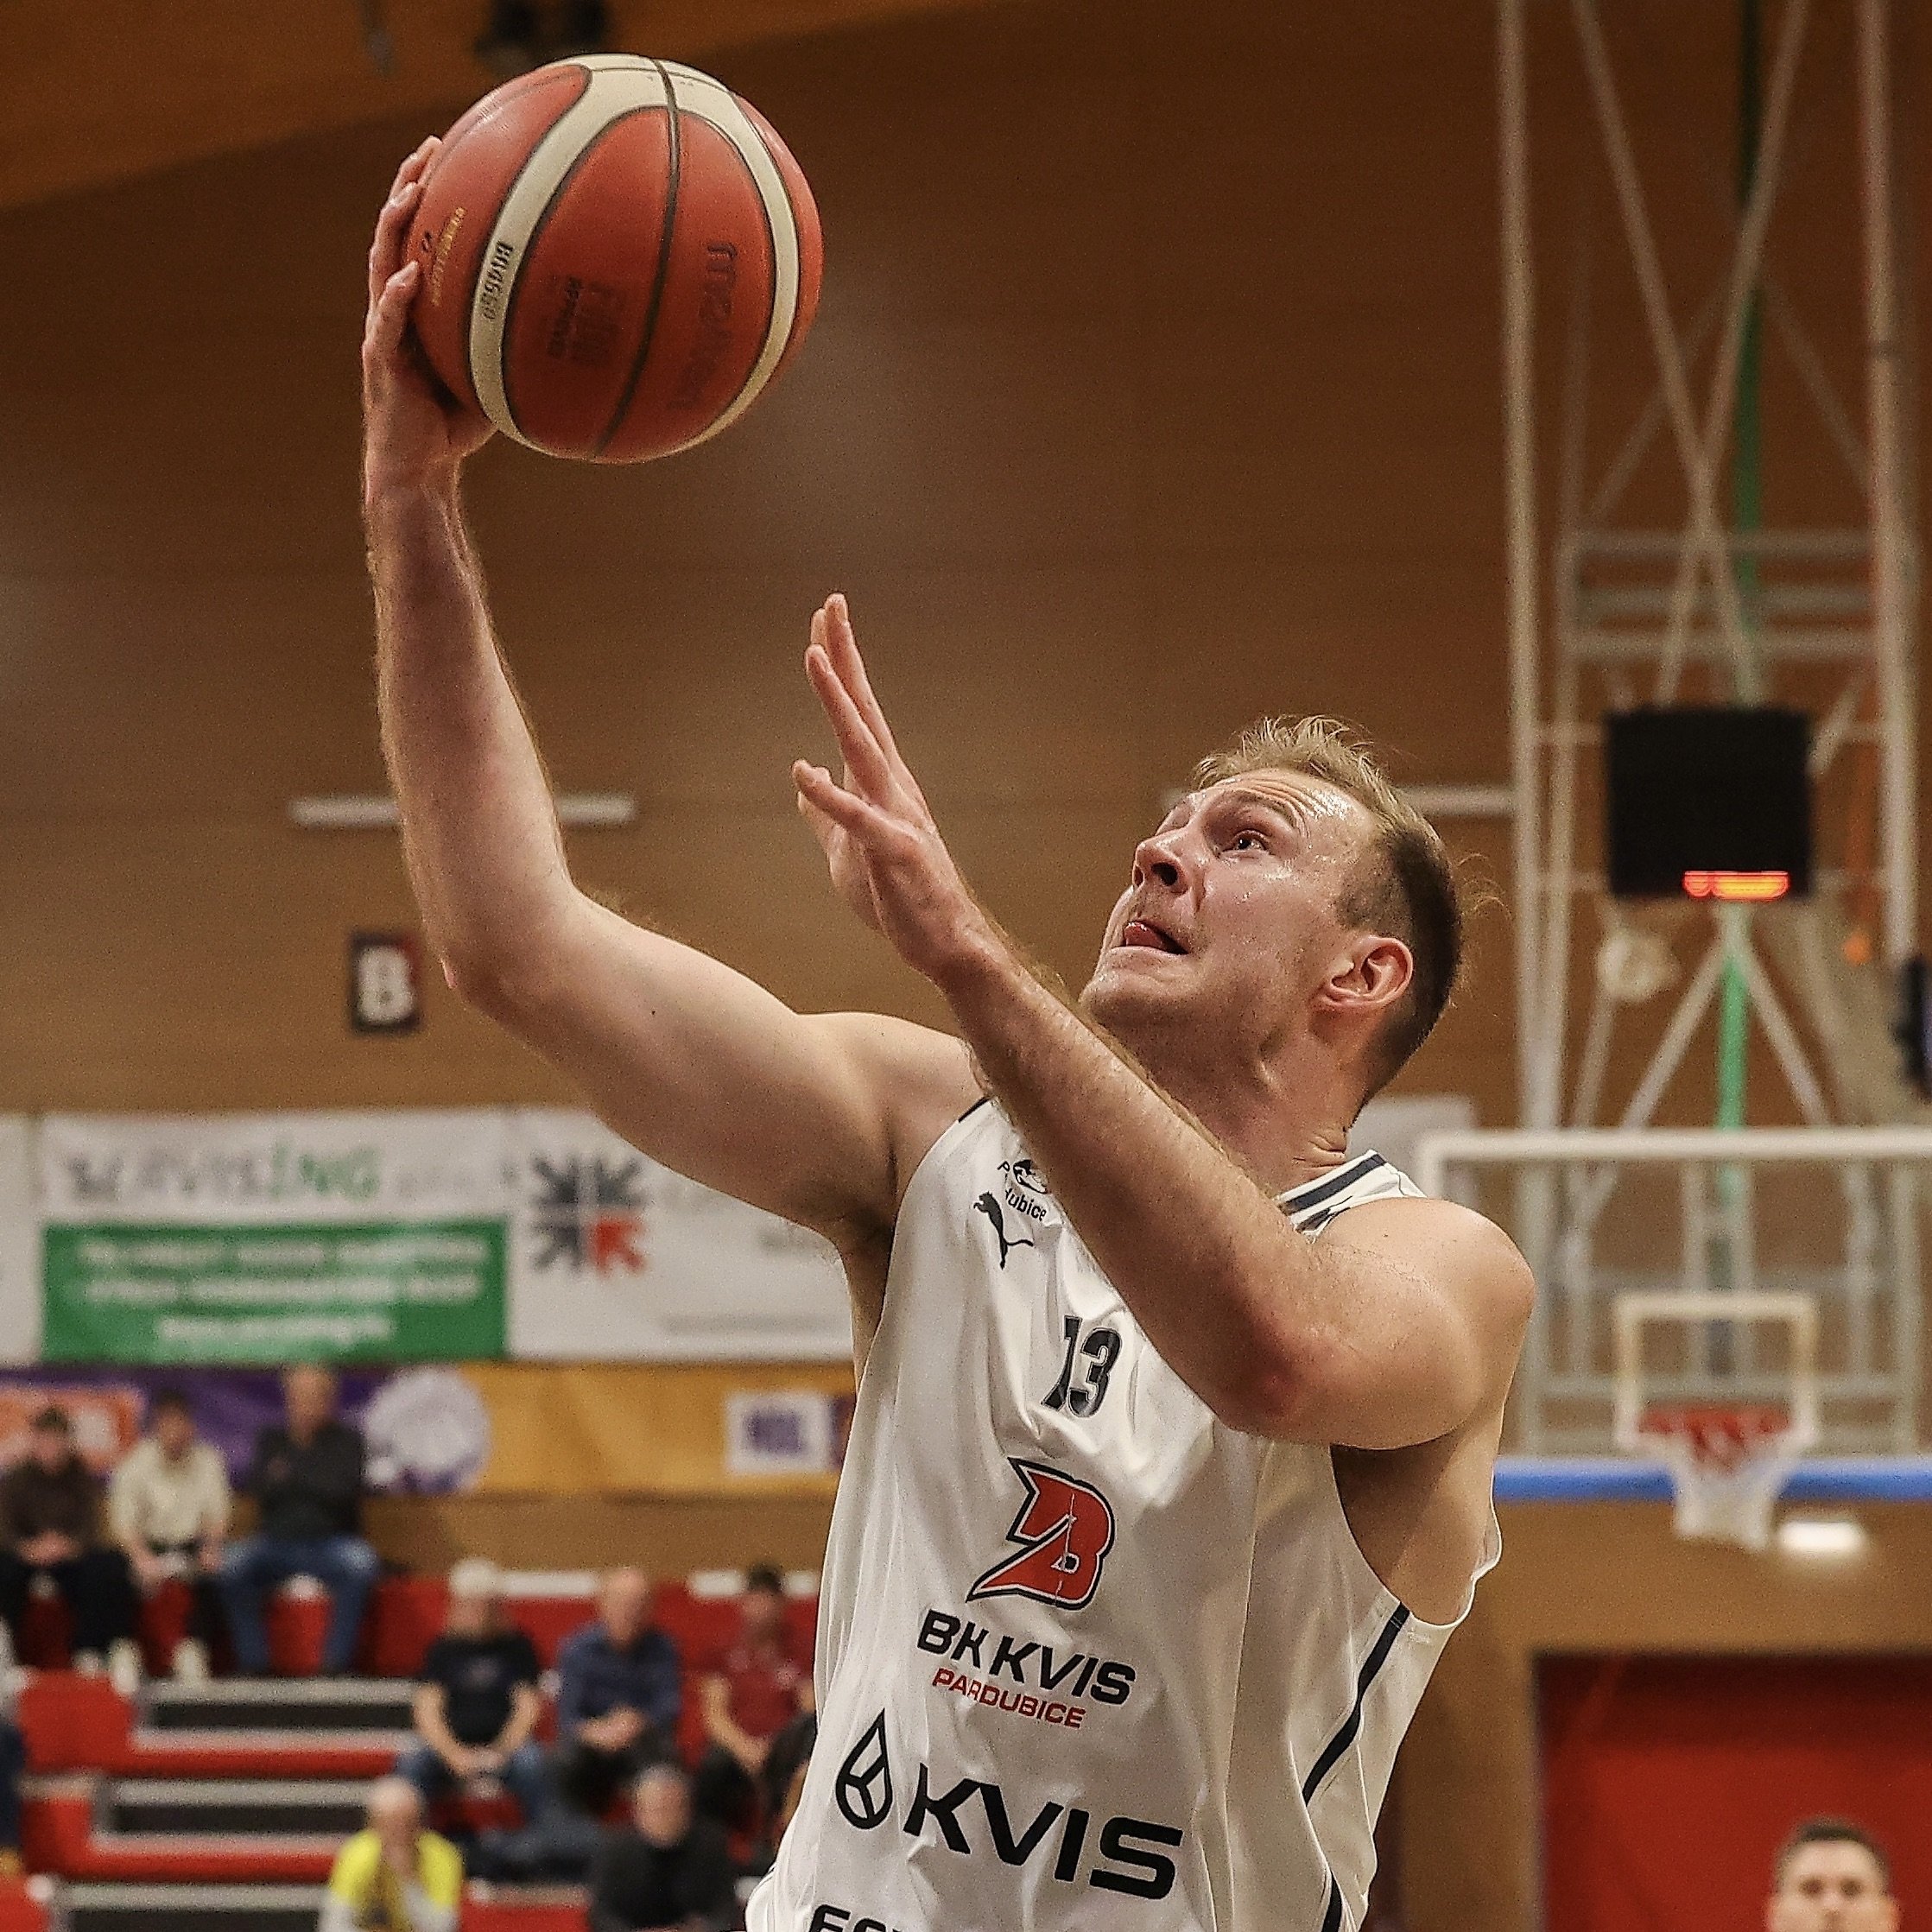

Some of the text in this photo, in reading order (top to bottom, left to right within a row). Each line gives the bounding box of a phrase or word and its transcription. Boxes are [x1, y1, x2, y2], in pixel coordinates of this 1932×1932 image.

[1040, 1314, 1123, 1417] 13
[917, 1610, 1137, 1705] BK KVIS
[933, 1669, 1086, 1728] PARDUBICE
[903, 1763, 1183, 1900] KVIS
